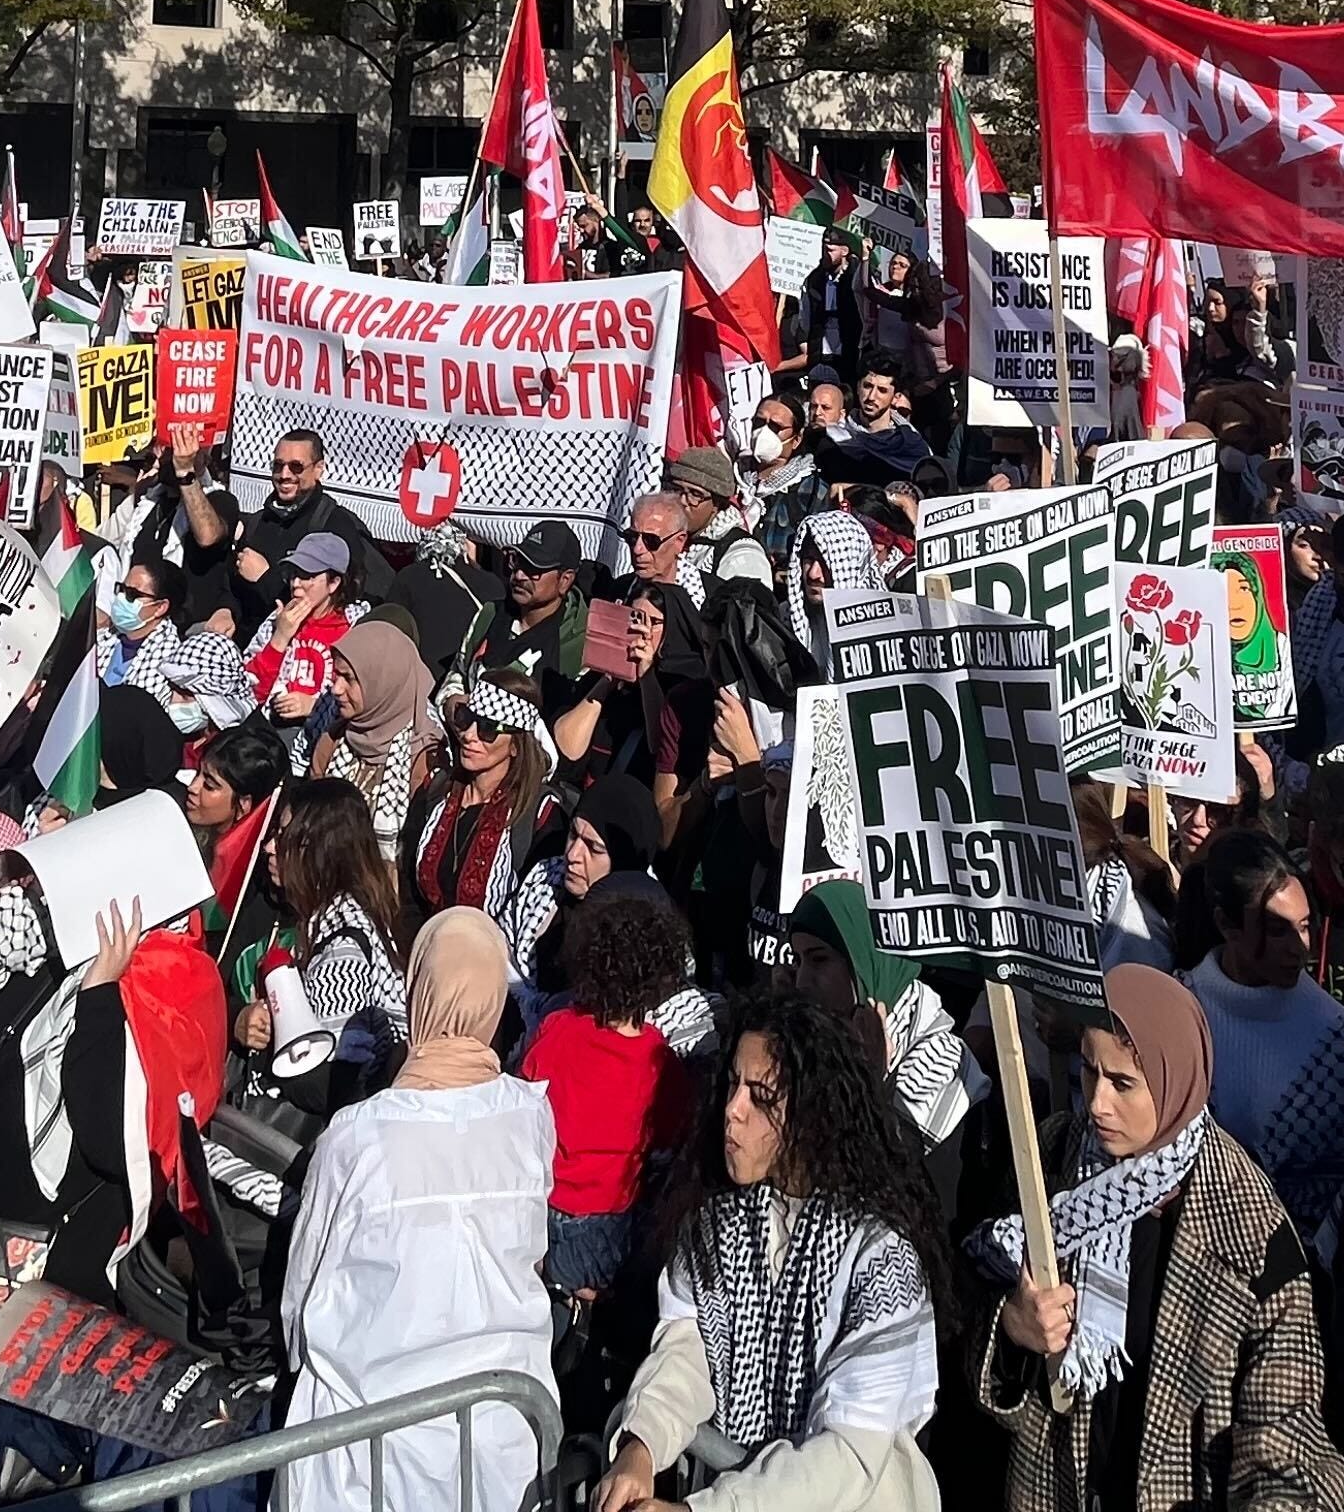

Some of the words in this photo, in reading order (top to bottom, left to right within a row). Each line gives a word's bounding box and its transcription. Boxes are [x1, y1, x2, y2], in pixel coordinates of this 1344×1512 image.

[104, 201, 138, 216] SAVE
[147, 203, 178, 219] THE
[215, 202, 258, 218] STOP
[858, 181, 910, 215] FREE
[359, 204, 393, 220] FREE
[313, 231, 342, 249] END
[847, 214, 914, 257] PALESTINE
[316, 251, 342, 264] THE
[992, 282, 1009, 308] IS
[257, 273, 460, 342] HEALTHCARE
[464, 298, 654, 352] WORKERS
[169, 340, 227, 361] CEASE
[994, 330, 1038, 353] WHEN
[103, 350, 149, 380] GAZA
[176, 367, 217, 388] FIRE
[994, 358, 1022, 379] ARE
[245, 333, 302, 391] FOR
[312, 351, 330, 396] A
[343, 353, 427, 410] FREE
[444, 359, 654, 429] PALESTINE
[173, 393, 216, 414] NOW
[1125, 465, 1155, 492] SIEGE
[1170, 451, 1192, 479] GAZA
[1193, 444, 1216, 472] NOW!
[927, 501, 972, 525] ANSWER
[923, 537, 950, 567] END
[954, 531, 980, 558] THE
[985, 519, 1023, 552] SIEGE
[1026, 515, 1043, 542] ON
[1046, 501, 1075, 533] GAZA
[1077, 491, 1110, 523] NOW!
[1223, 535, 1280, 553] GENOCIDE
[837, 600, 893, 626] ANSWER
[841, 647, 873, 679] END
[875, 639, 906, 669] THE
[908, 634, 949, 668] SIEGE
[952, 631, 973, 667] ON
[976, 633, 1009, 668] GAZA
[1011, 631, 1050, 665] NOW!
[1258, 673, 1283, 689] NOT
[1239, 689, 1278, 704] ENEMY
[1076, 694, 1118, 734] ISRAEL
[847, 680, 1079, 829] FREE
[1131, 736, 1156, 753] THE
[1158, 740, 1199, 758] SIEGE
[1123, 751, 1152, 769] GAZA
[1156, 758, 1207, 778] NOW!
[867, 827, 1086, 909] PALESTINE!
[879, 912, 910, 947] END
[917, 908, 951, 945] ALL
[956, 909, 986, 946] U.S.
[992, 909, 1019, 947] AID
[1021, 916, 1040, 951] TO
[1044, 920, 1096, 965] ISRAEL
[997, 963, 1103, 996] @ANSWERCOALITION
